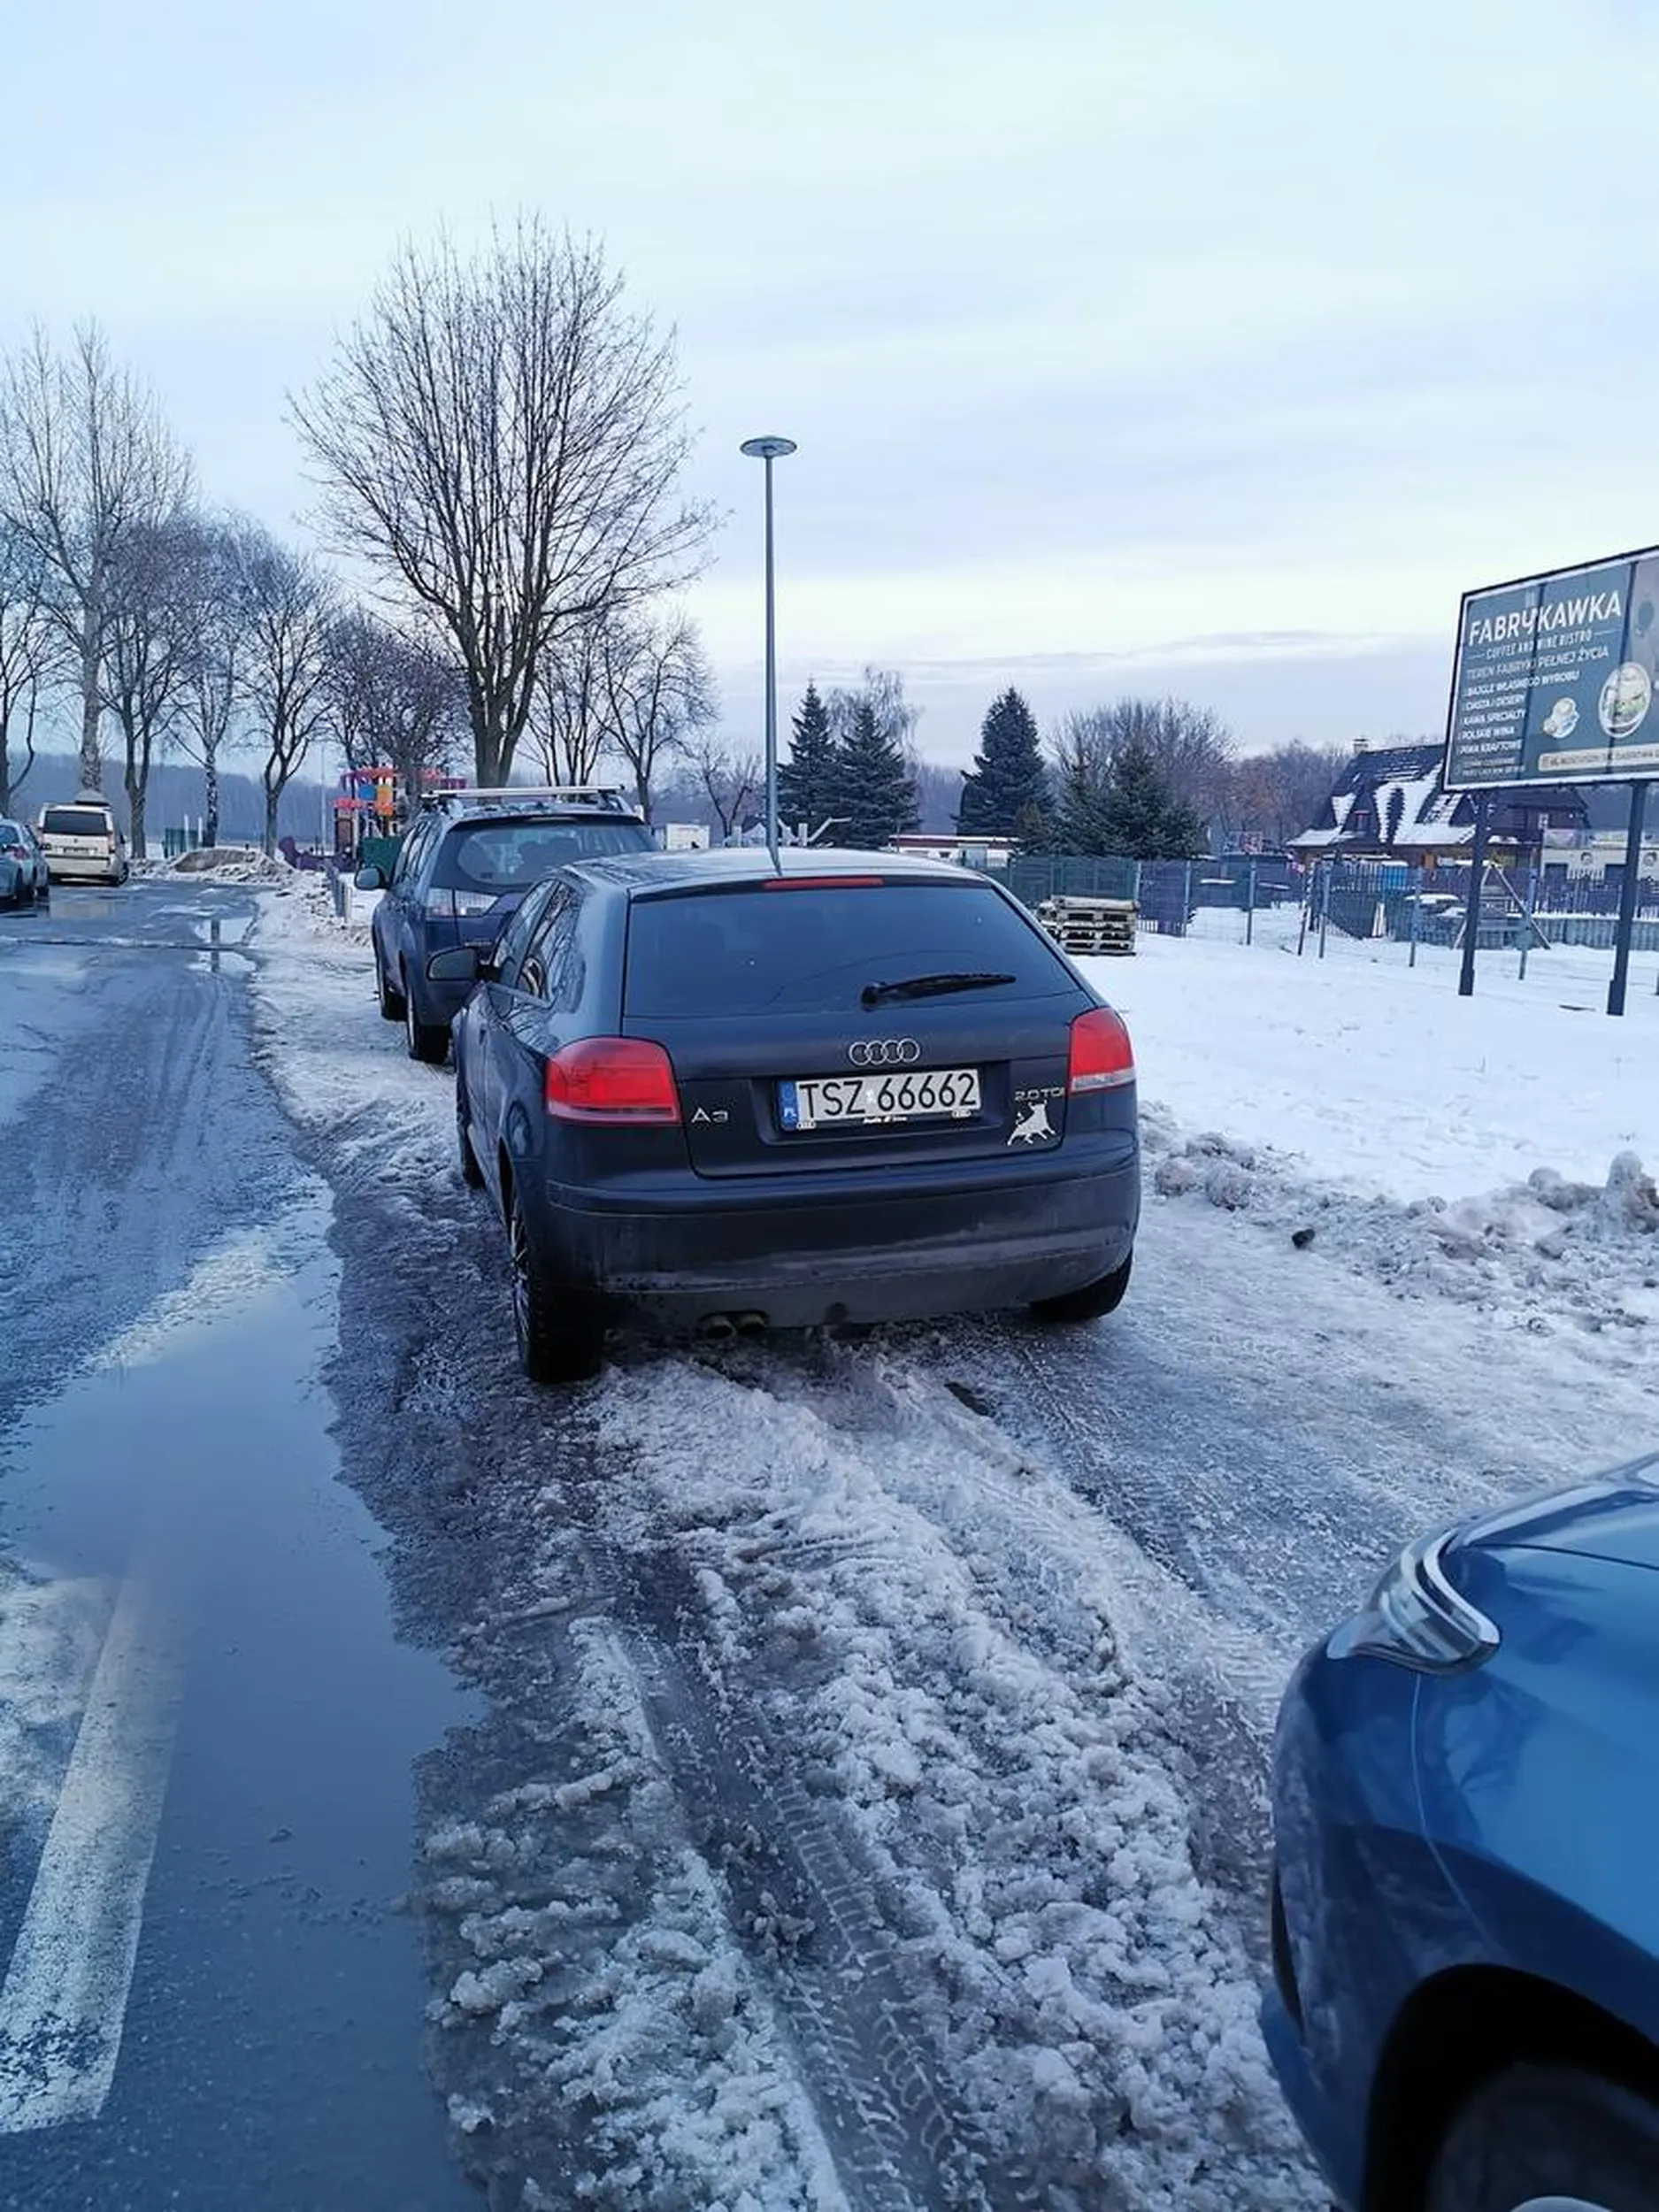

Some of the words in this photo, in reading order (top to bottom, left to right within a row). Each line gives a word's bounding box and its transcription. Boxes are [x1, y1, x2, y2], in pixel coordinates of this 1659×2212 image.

[1468, 590, 1622, 647] FABRYKAWKA
[1559, 629, 1593, 648] BISTRO
[799, 1079, 865, 1118] TSZ
[877, 1072, 977, 1112] 66662
[691, 1107, 728, 1123] A3
